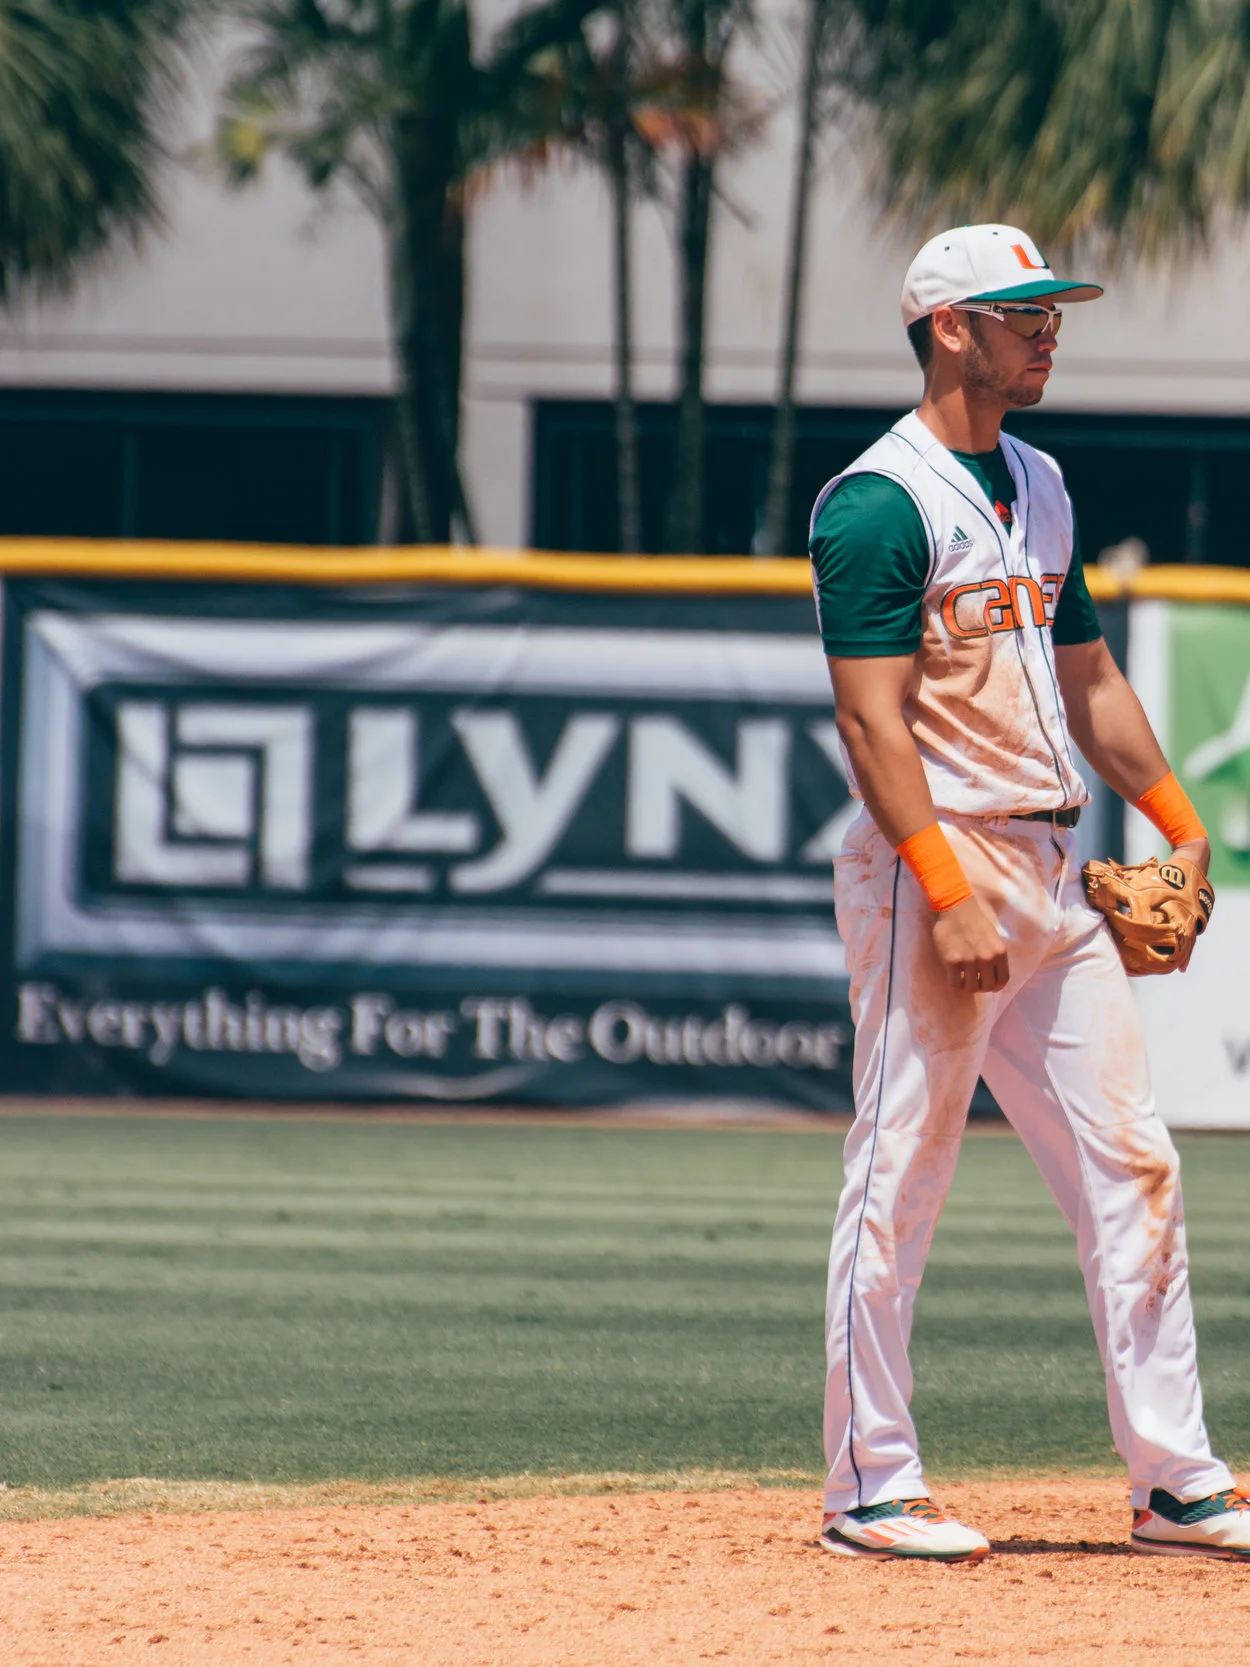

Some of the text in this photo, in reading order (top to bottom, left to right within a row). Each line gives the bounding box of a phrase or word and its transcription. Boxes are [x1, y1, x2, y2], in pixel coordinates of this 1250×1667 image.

[948, 540, 974, 553] adidas
[17, 981, 846, 1072] Everything For The Outdoor
